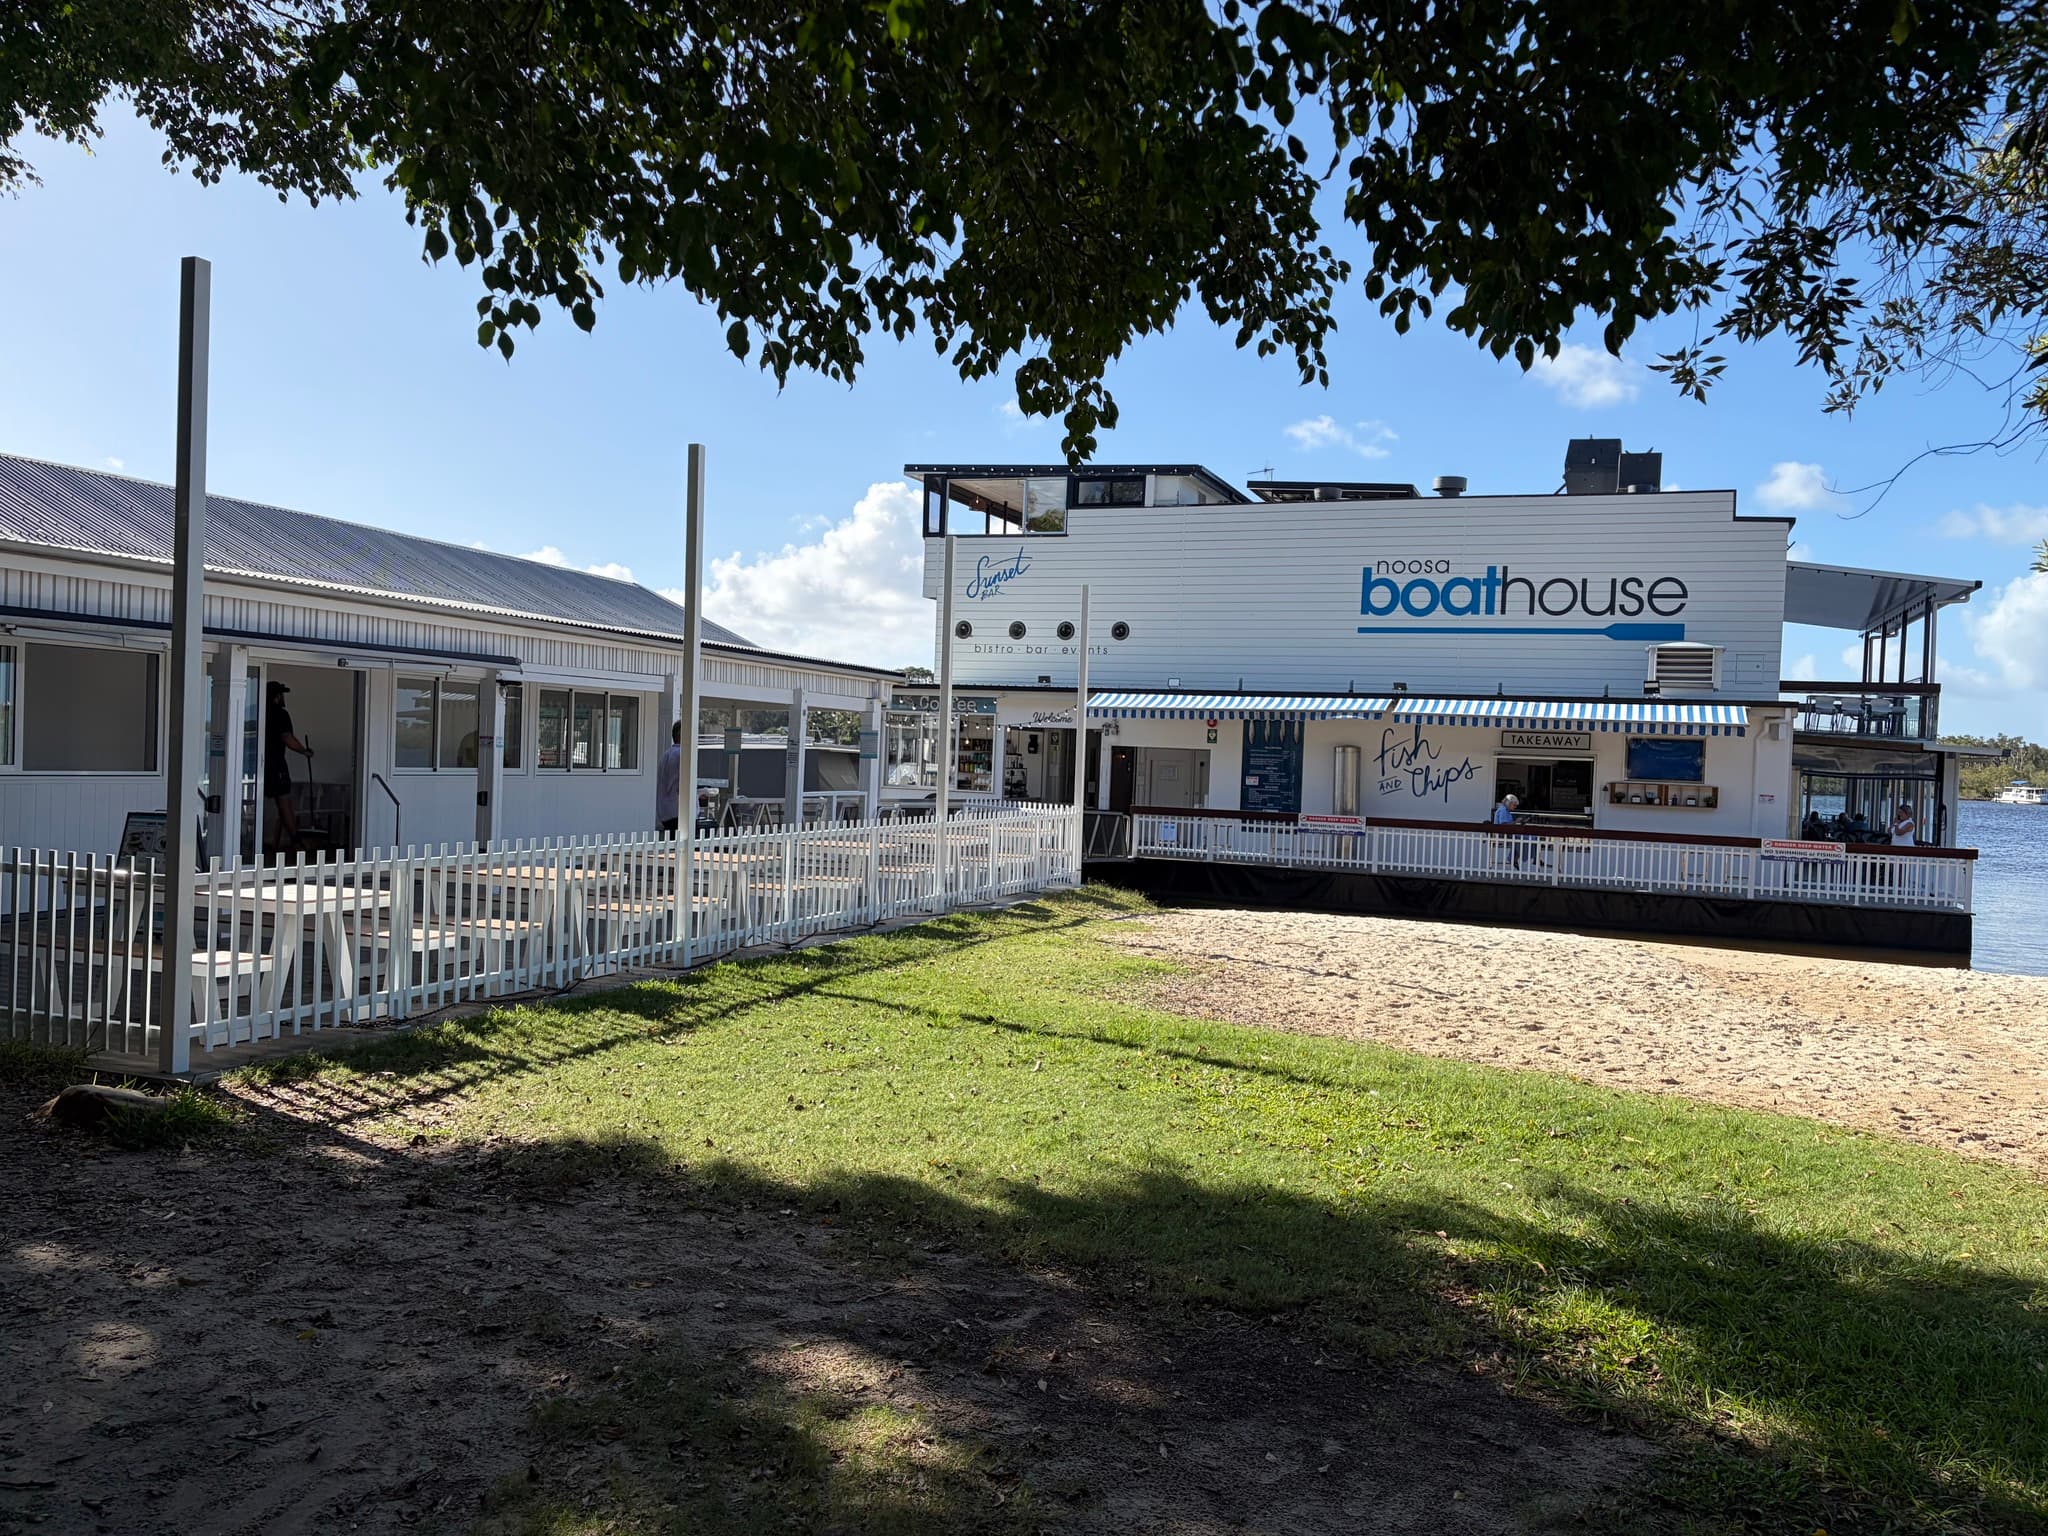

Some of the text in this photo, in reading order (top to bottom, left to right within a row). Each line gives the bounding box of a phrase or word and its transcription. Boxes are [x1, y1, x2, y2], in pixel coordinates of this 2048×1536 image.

[966, 546, 1033, 598] Sunset
[1376, 559, 1450, 575] noosa
[980, 585, 1005, 601] BAR
[1360, 565, 1689, 617] boathouse
[974, 643, 1109, 656] bistro bar evnts
[919, 695, 977, 711] Coee
[1032, 711, 1074, 724] Welcome
[1511, 733, 1581, 747] TAKEAWAY
[1379, 779, 1401, 792] AND
[1403, 757, 1482, 803] Chips
